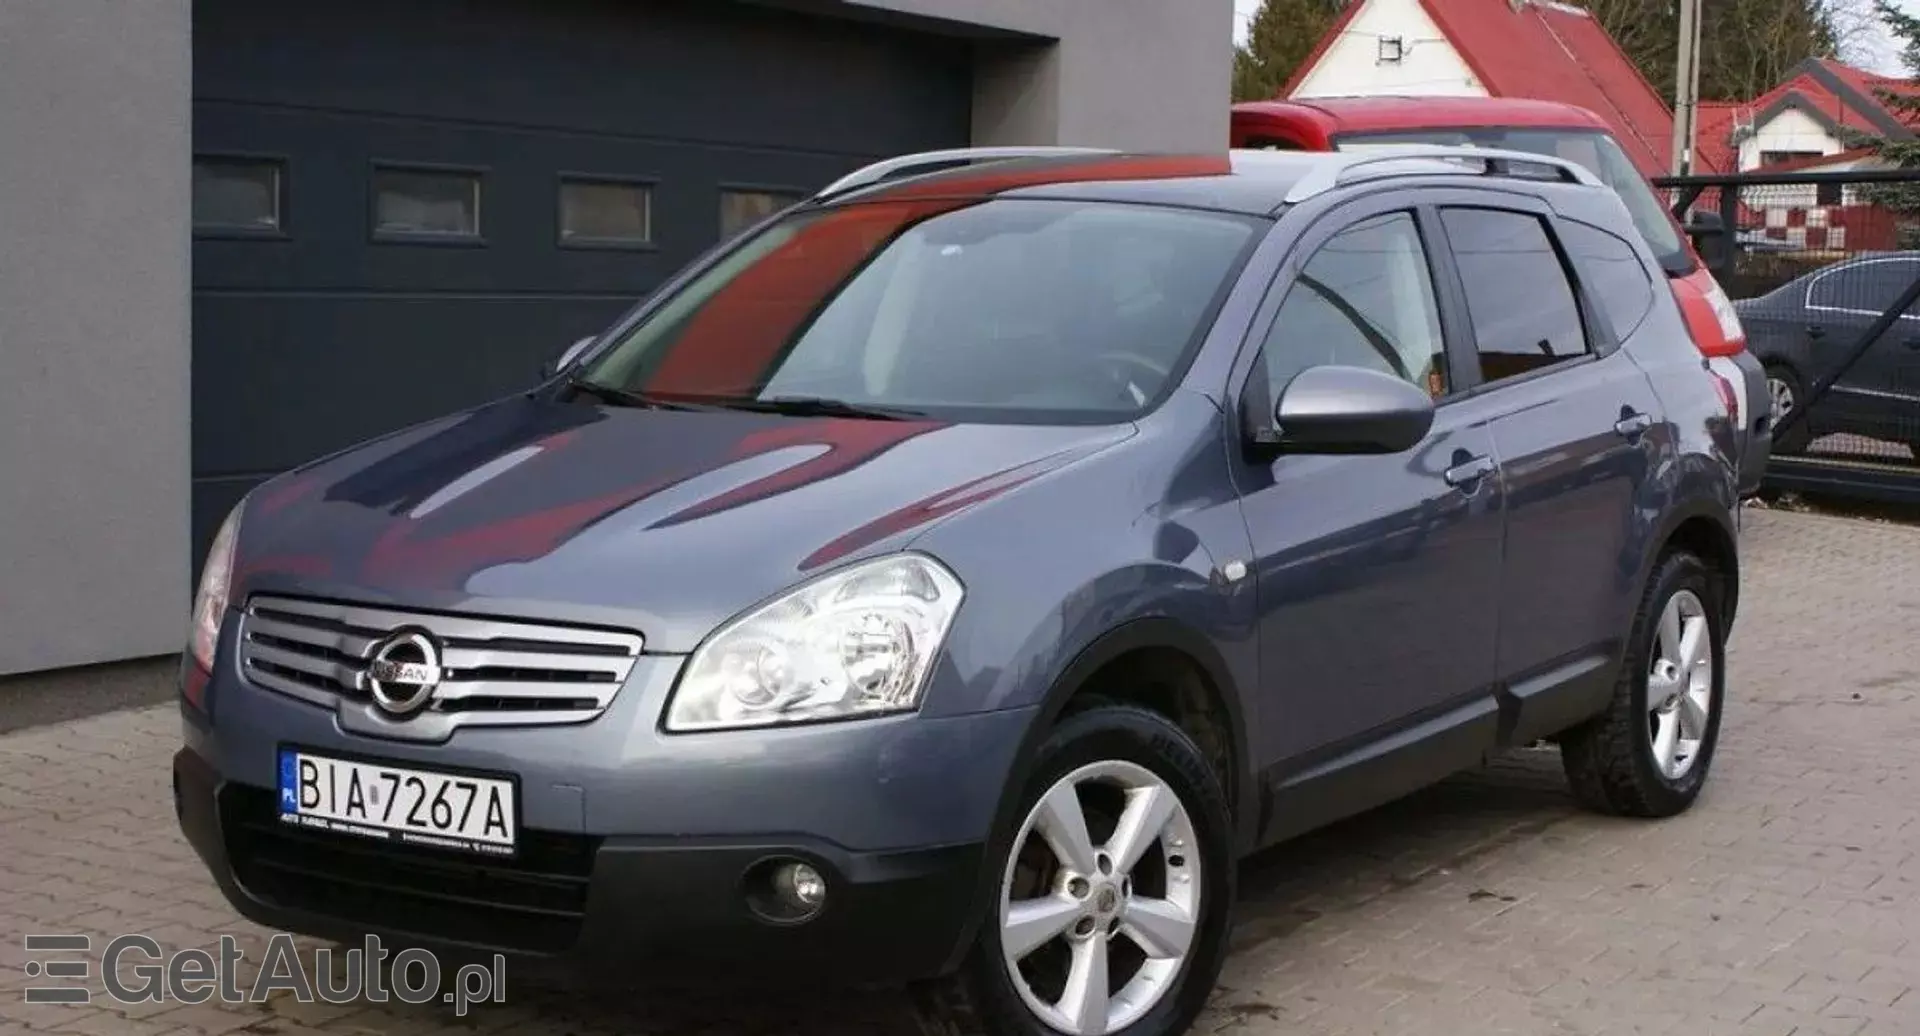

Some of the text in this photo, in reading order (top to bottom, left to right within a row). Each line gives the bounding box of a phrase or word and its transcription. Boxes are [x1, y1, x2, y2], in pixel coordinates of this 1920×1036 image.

[282, 787, 296, 803] PL
[299, 759, 367, 819] BIA
[380, 772, 508, 838] 7267A
